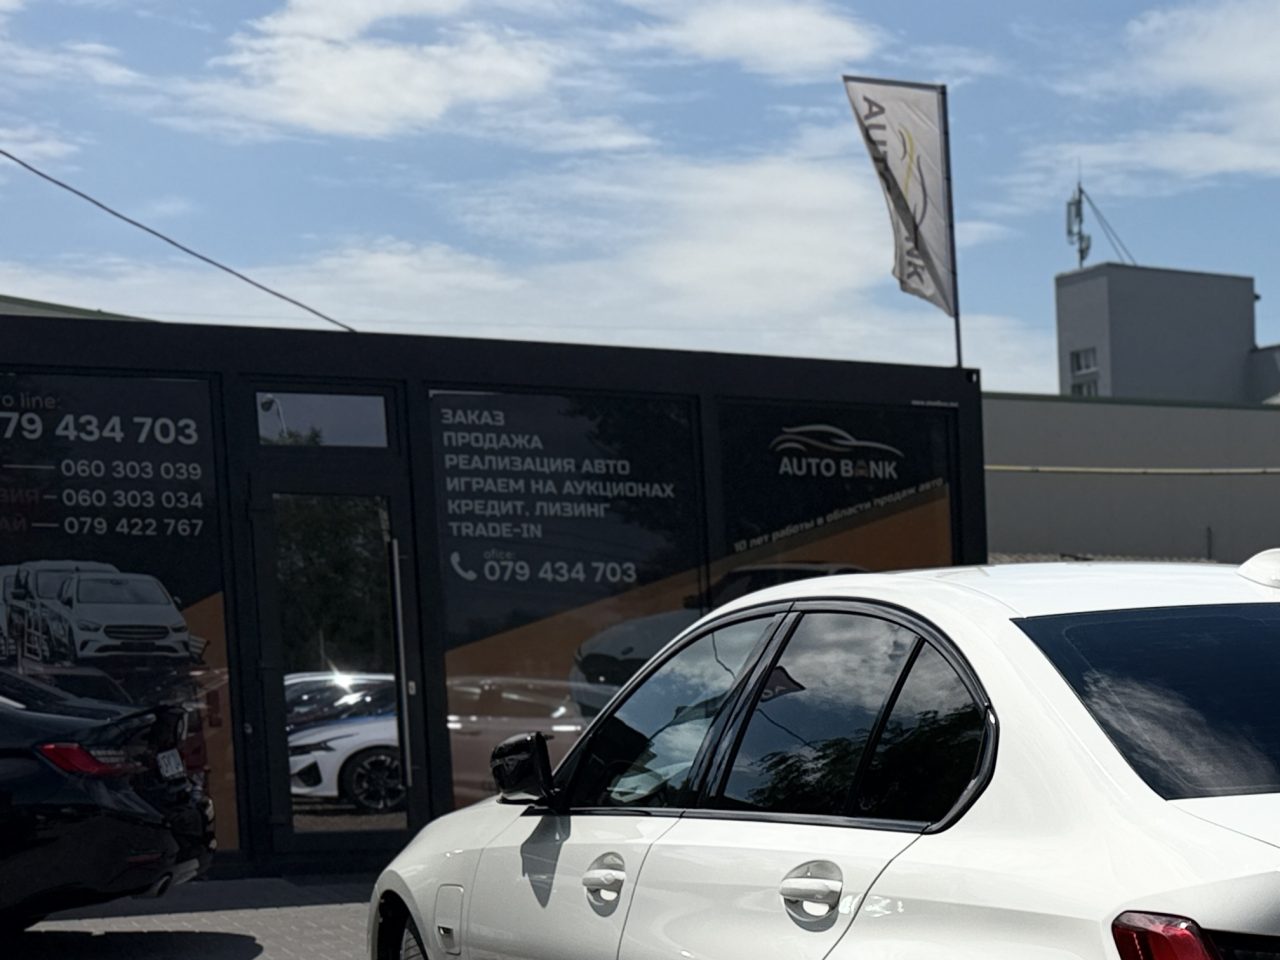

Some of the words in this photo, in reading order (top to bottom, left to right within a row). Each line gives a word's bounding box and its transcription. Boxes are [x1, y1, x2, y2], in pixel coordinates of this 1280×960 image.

[0, 393, 15, 408] o
[440, 408, 506, 426] ЗАКАЗ
[55, 414, 125, 443] 434
[132, 416, 199, 446] 703
[442, 431, 544, 451] ПРОДАЖА
[60, 459, 105, 478] 060
[112, 460, 154, 479] 303
[159, 462, 202, 480] 039
[444, 454, 577, 475] РЕАЛИЗАЦИЯ
[581, 458, 631, 476] АВТО
[778, 455, 836, 478] AUTO
[446, 476, 525, 495] ИГРАЕМ
[530, 479, 558, 495] НА
[562, 480, 676, 499] АУКЦИОНАХ
[61, 488, 107, 507] 060
[113, 489, 155, 508] 303
[161, 490, 204, 509] 034
[534, 501, 611, 519] ЛИЗИНГ
[64, 516, 108, 535] 079
[115, 517, 158, 536] 422
[163, 518, 204, 537] 767
[448, 521, 543, 539] TRADE-IN
[771, 519, 815, 544] работы
[483, 560, 531, 582] 079
[538, 562, 587, 583] 434
[591, 561, 638, 584] 703
